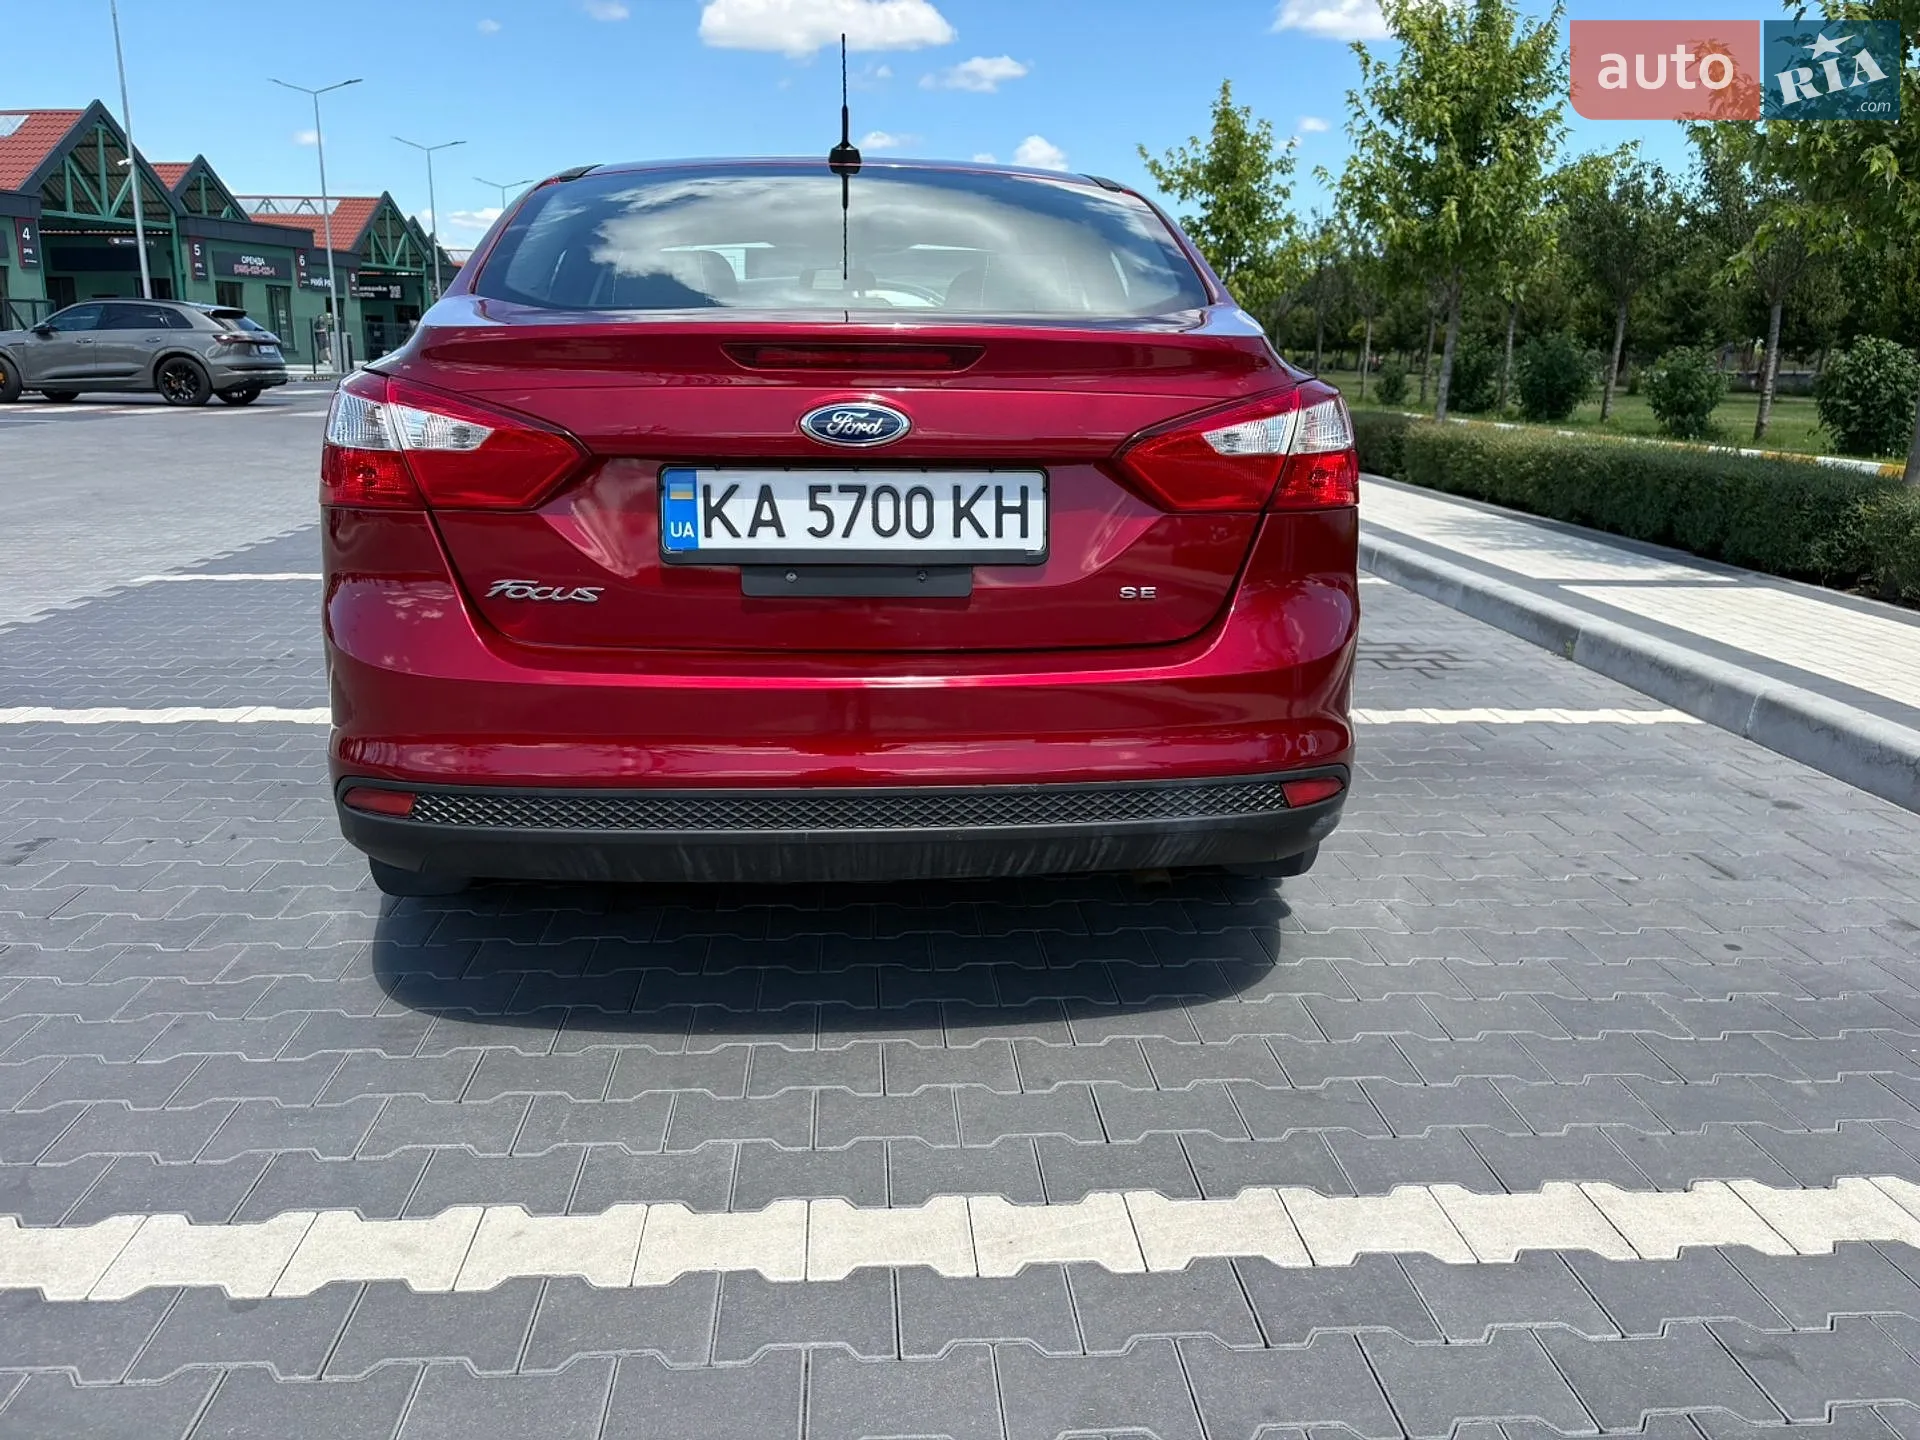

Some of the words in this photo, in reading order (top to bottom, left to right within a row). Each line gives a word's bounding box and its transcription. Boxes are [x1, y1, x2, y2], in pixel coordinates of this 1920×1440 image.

[22, 227, 31, 241] 4
[193, 243, 201, 257] 5
[826, 410, 883, 436] Ford
[701, 484, 787, 539] KA
[806, 484, 936, 539] 5700
[952, 484, 1029, 539] KH
[670, 521, 695, 539] UA
[1119, 585, 1157, 599] SE
